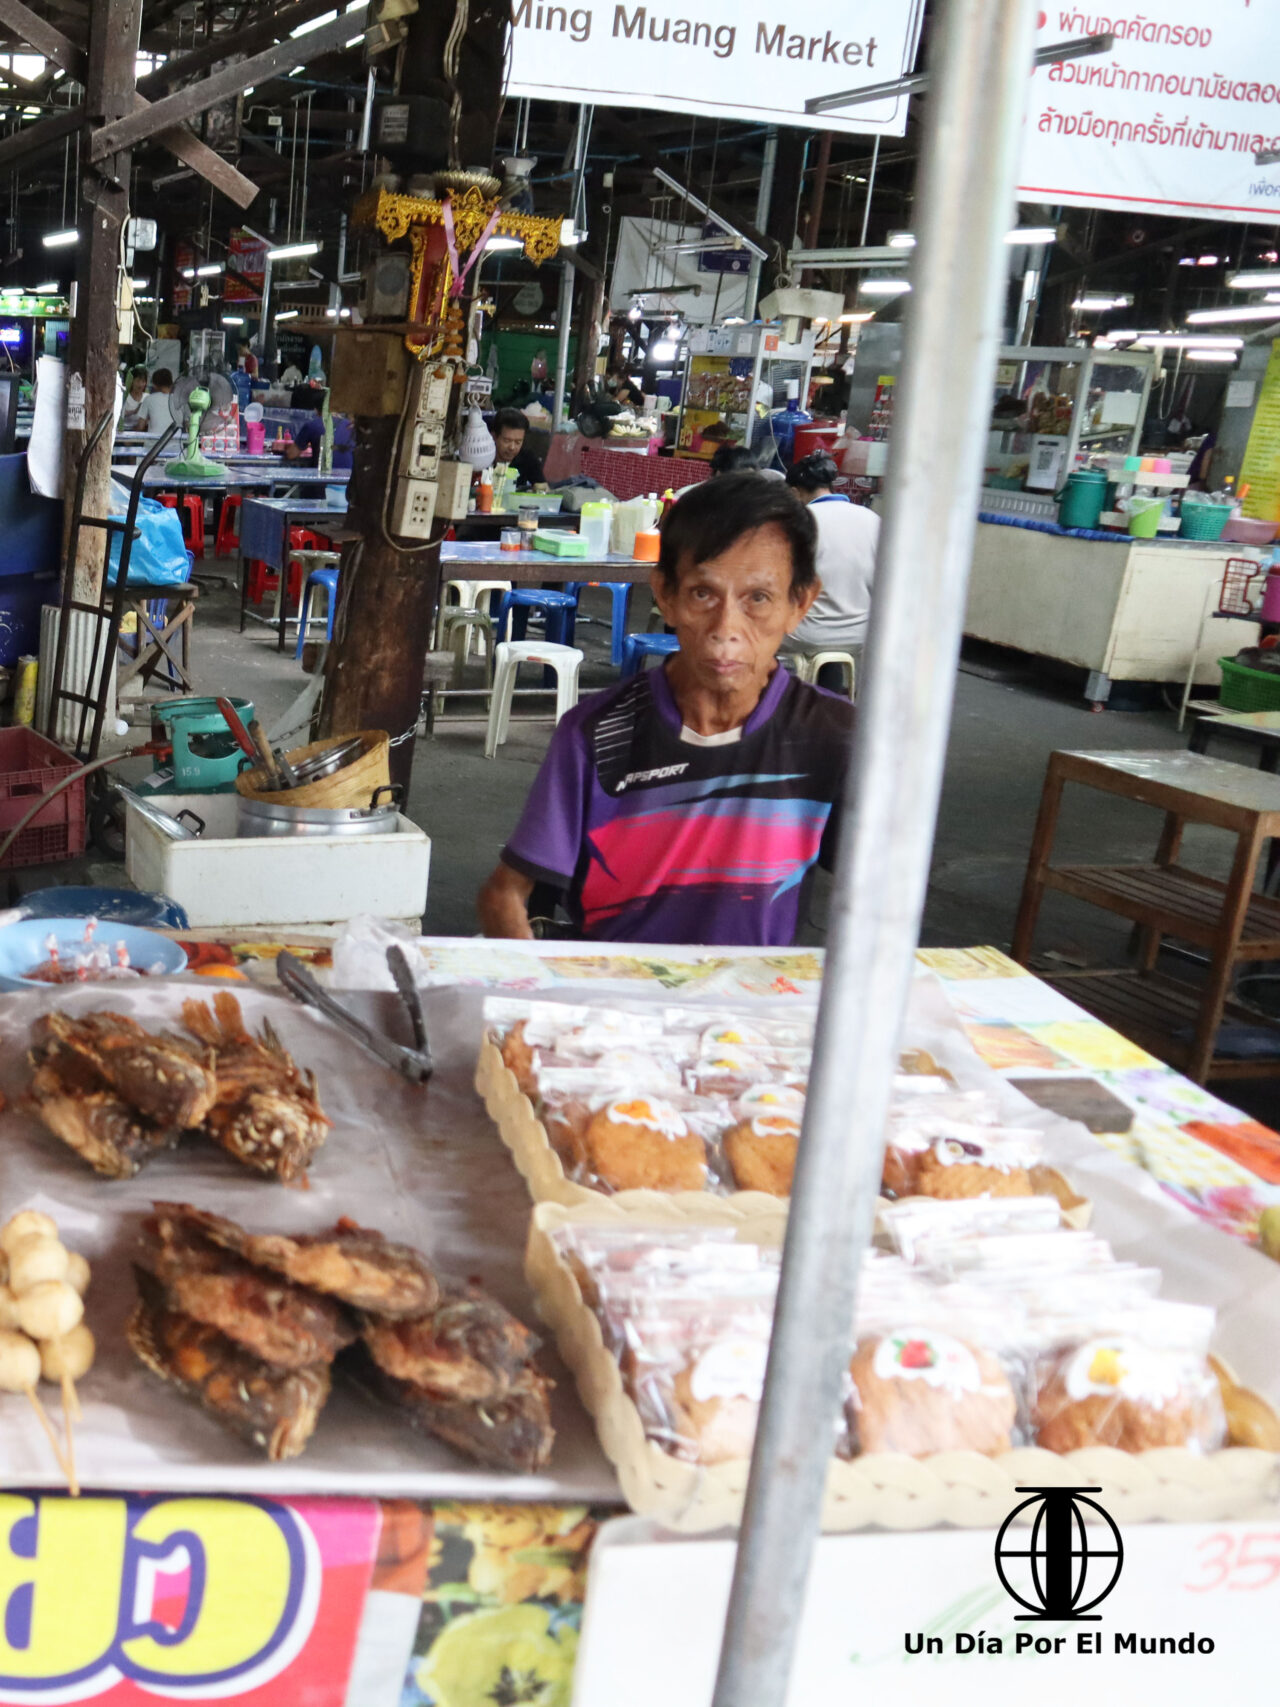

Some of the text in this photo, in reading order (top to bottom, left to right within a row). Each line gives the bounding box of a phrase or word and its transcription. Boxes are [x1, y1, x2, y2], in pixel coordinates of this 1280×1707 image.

[612, 4, 737, 59] Muang
[754, 21, 878, 68] Market
[1059, 7, 1213, 48] ผ่านจดคัดกรอง
[1048, 60, 1280, 104] สวมหน้ากากอนามัยตลอ
[1183, 1531, 1280, 1594] 35
